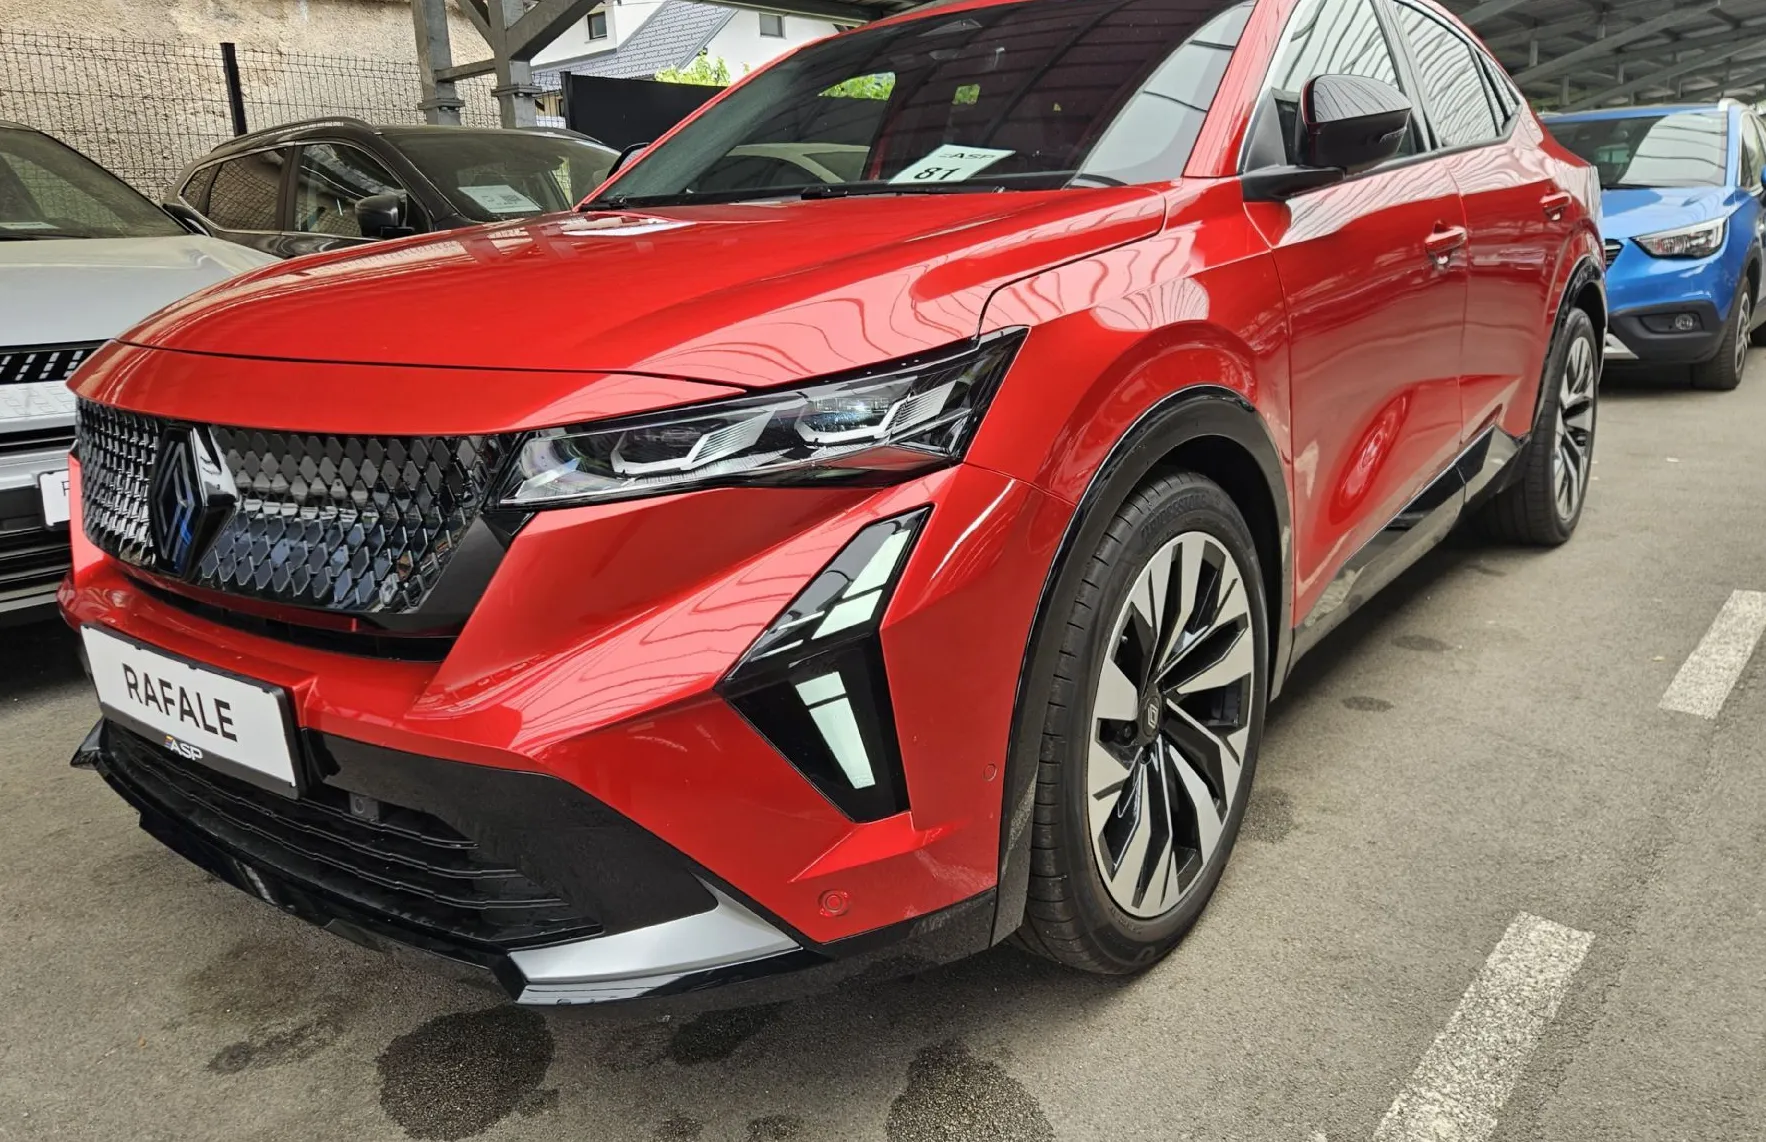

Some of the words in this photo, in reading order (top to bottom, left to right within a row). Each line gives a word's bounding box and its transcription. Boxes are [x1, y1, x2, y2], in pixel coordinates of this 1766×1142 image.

[914, 168, 961, 181] 81
[122, 663, 237, 742] RAFALE
[170, 740, 203, 760] ASP
